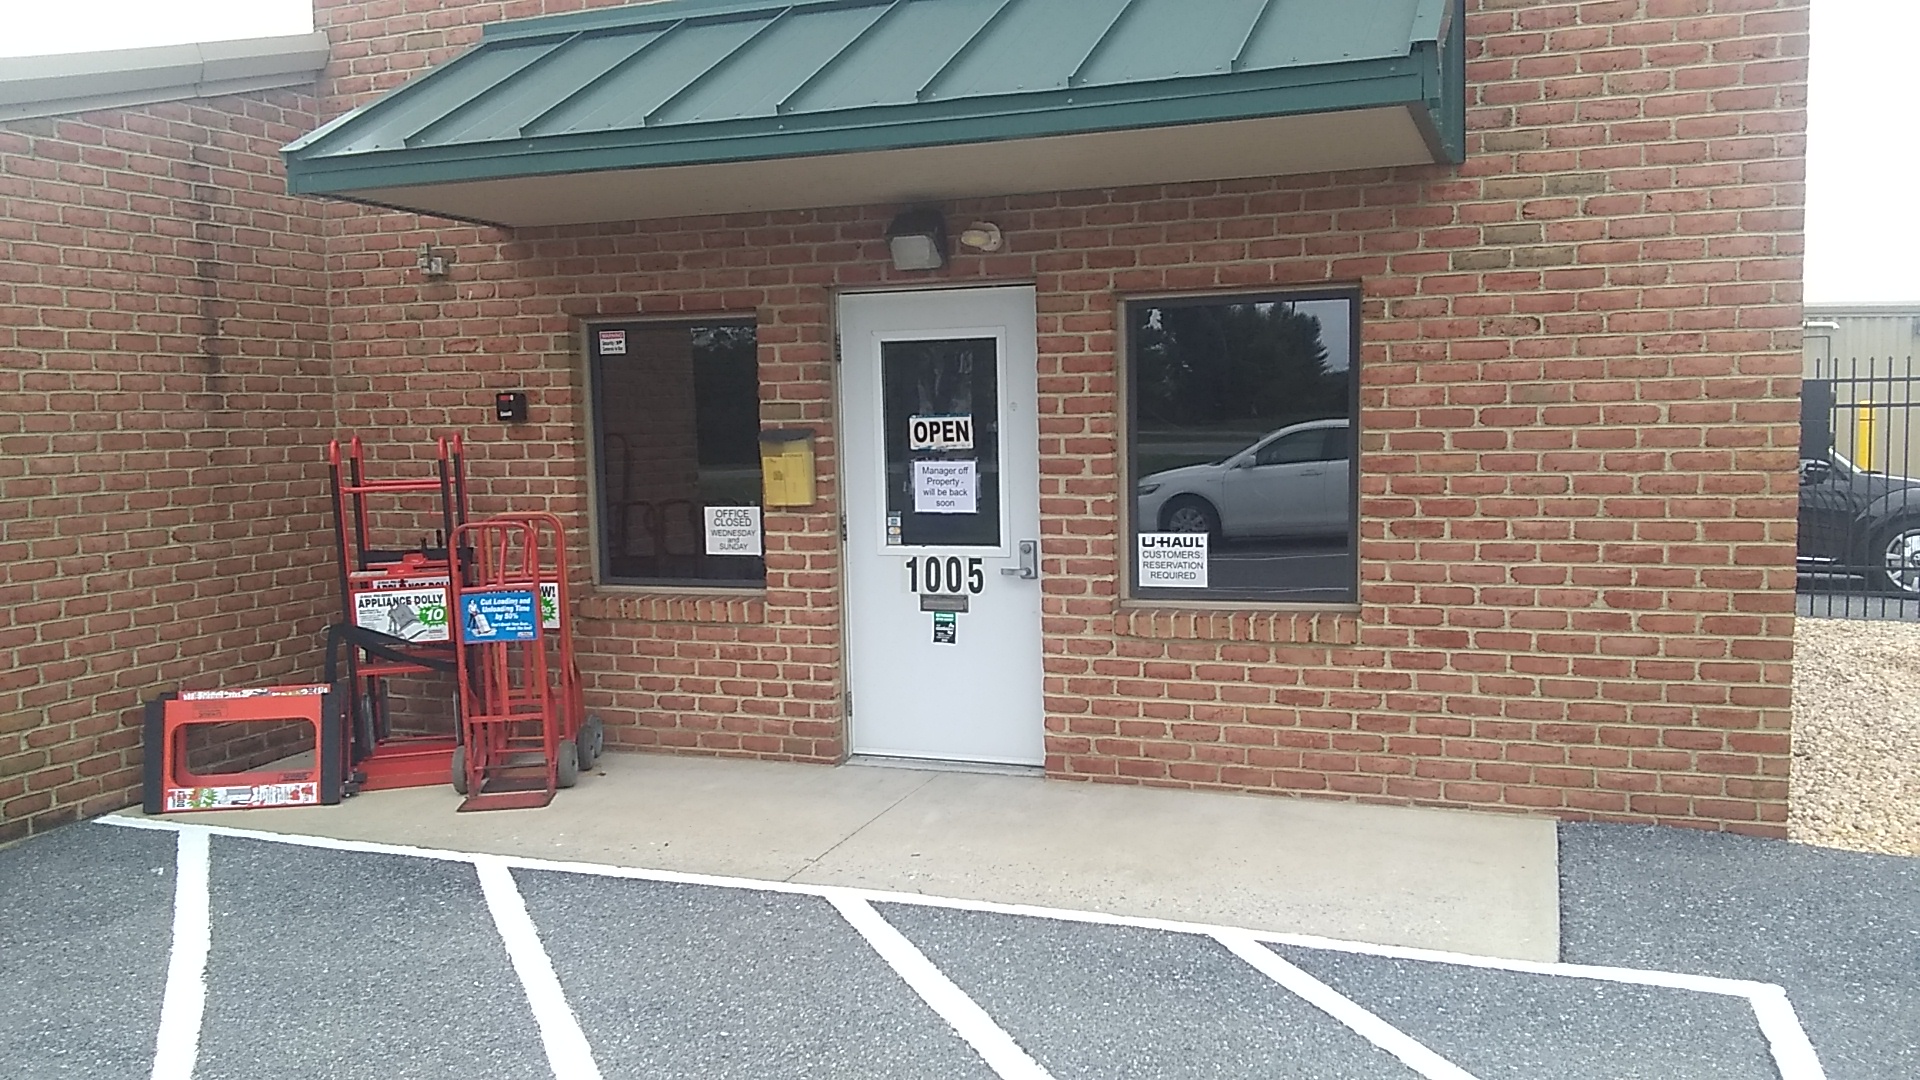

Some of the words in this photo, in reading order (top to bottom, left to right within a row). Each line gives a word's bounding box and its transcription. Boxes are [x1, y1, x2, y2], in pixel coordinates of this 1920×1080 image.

[914, 420, 970, 443] OPEN
[922, 466, 957, 476] Manager
[958, 466, 968, 474] off
[927, 477, 960, 487] Property
[923, 488, 935, 496] will
[937, 488, 947, 496] be
[949, 488, 968, 496] back
[715, 509, 750, 518] OFFICE
[713, 518, 752, 527] CLOSED
[711, 529, 756, 537] WEDNESDAY
[1142, 550, 1203, 559] CUSTOMERS:
[1142, 561, 1204, 570] RESERVATION
[906, 556, 984, 594] 1005
[1150, 571, 1197, 580] REQUIRED
[358, 595, 412, 609] APPLIANCE
[414, 594, 444, 605] DOLLY
[480, 598, 492, 606] Cut
[493, 597, 518, 605] Loading
